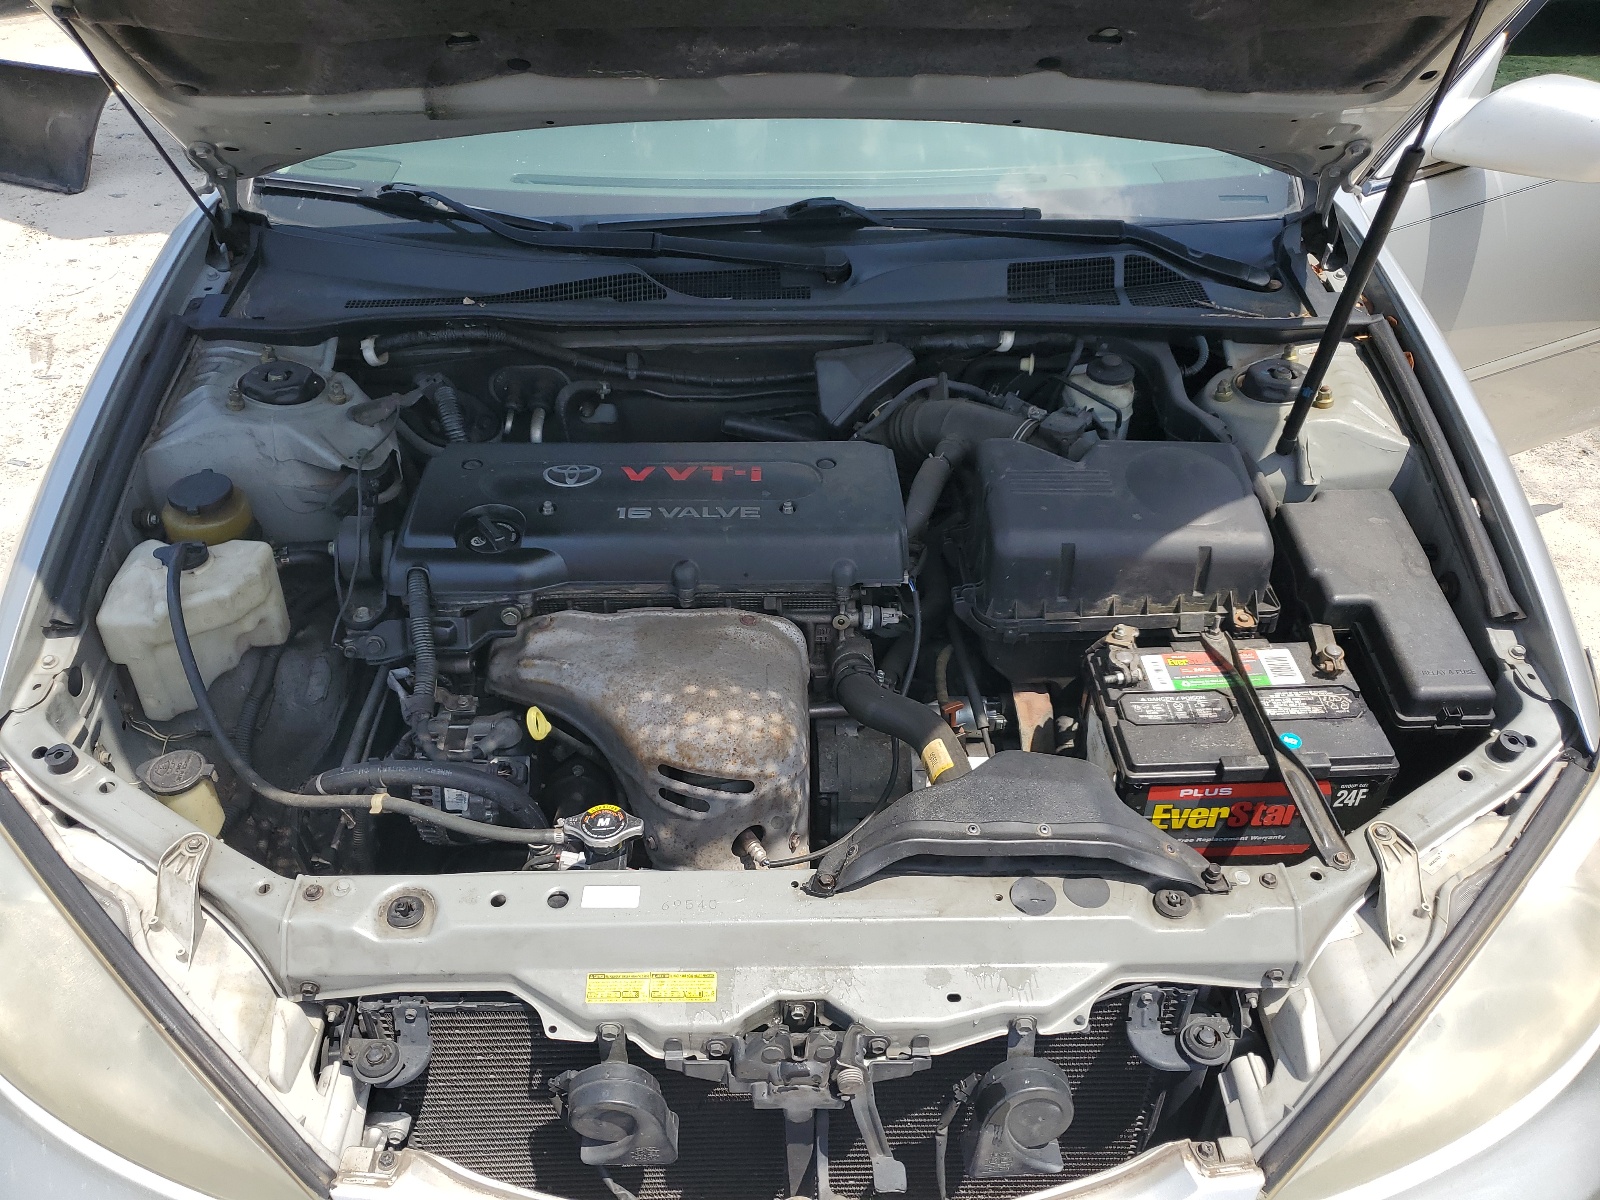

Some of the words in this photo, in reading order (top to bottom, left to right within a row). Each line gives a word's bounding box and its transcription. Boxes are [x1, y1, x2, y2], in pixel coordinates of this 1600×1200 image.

[616, 506, 652, 519] 16
[657, 506, 761, 519] VALVE
[1179, 787, 1233, 798] PLUS
[1332, 788, 1370, 808] 24F
[1151, 801, 1299, 830] EverStar
[1250, 834, 1287, 843] Warranty
